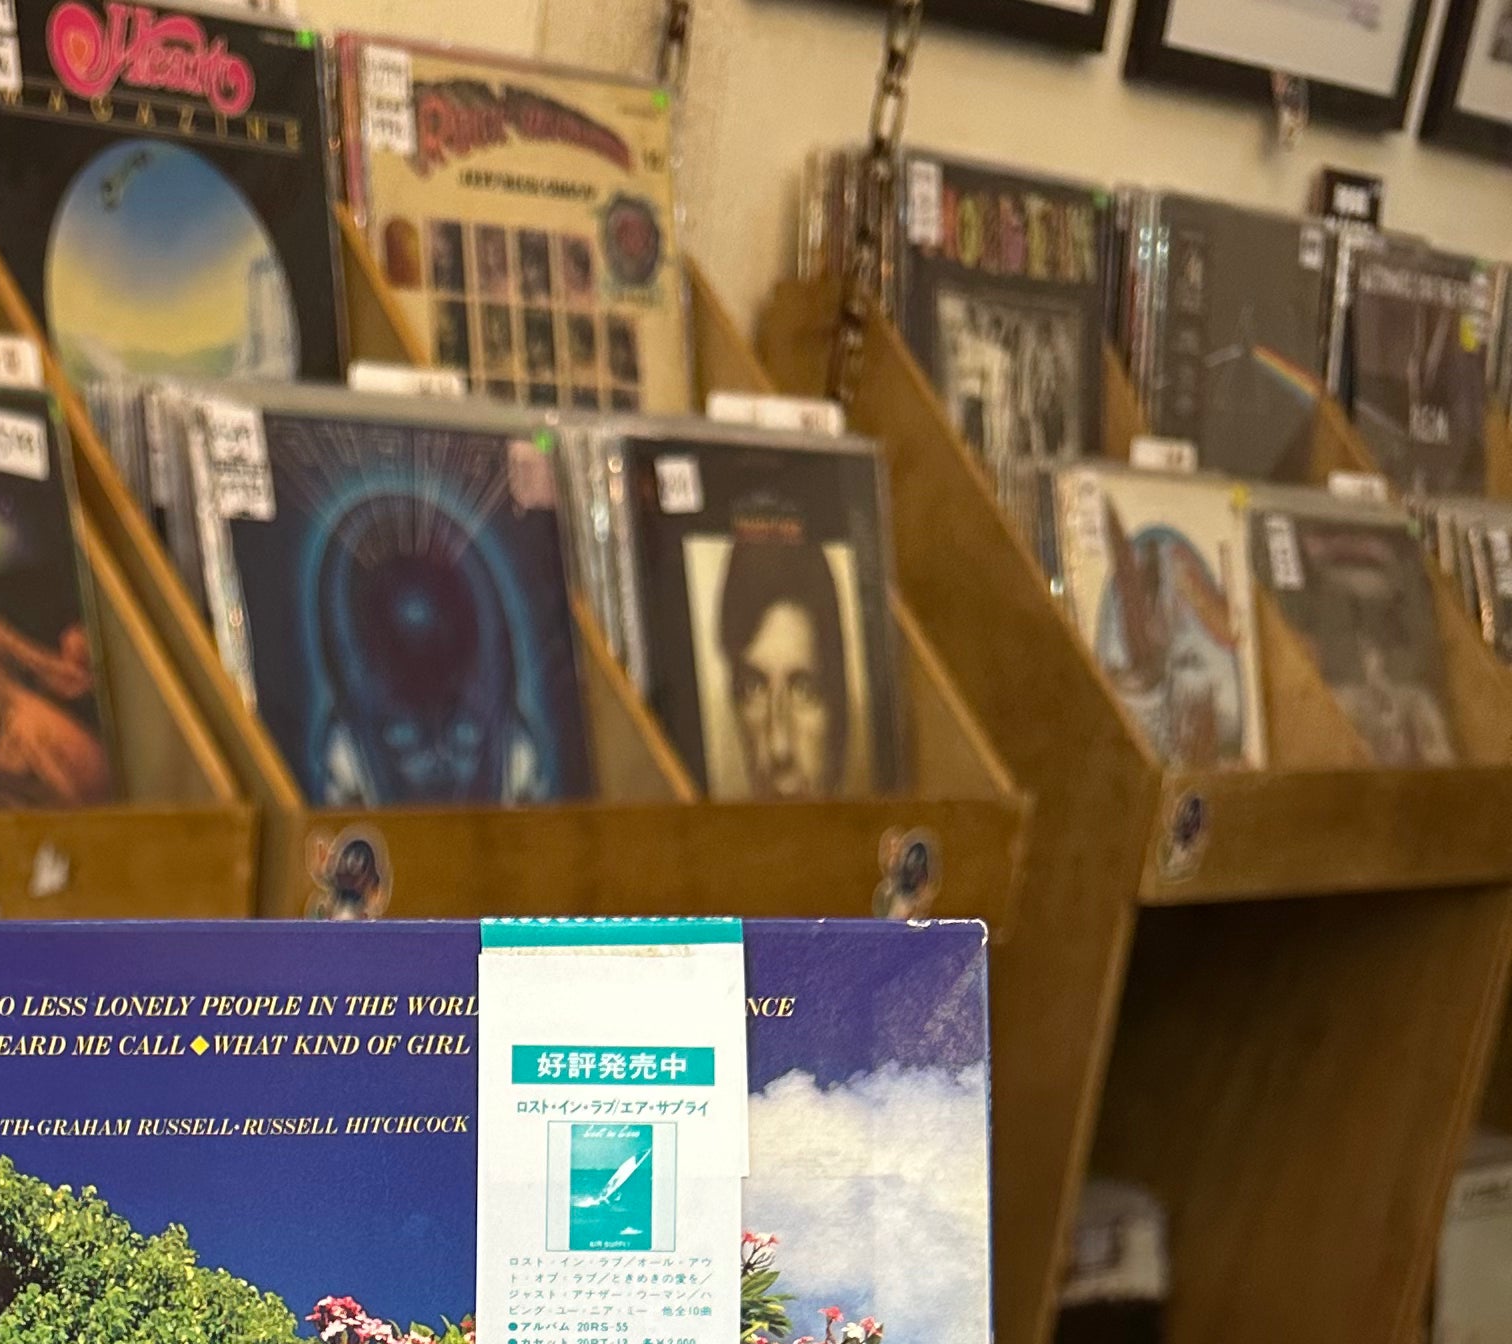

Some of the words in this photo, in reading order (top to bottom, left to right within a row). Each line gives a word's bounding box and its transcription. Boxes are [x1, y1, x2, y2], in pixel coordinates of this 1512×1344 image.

[22, 996, 88, 1017] LESS
[94, 996, 196, 1017] LONELY
[200, 996, 302, 1017] PEOPLE
[308, 996, 338, 1017] IN
[345, 996, 398, 1017] THE
[407, 996, 478, 1017] WORL
[746, 996, 795, 1017] NCE
[76, 1035, 112, 1056] ME
[119, 1035, 186, 1056] CALL
[214, 1035, 288, 1056] WHAT
[293, 1035, 360, 1056] KIND
[367, 1035, 401, 1056] OF
[407, 1035, 471, 1056] GIRL
[538, 1051, 687, 1079] 好評発売中
[37, 1116, 131, 1134] GRAHAM
[137, 1116, 234, 1134] RUSSELL
[241, 1116, 338, 1134] RUSSELL
[345, 1116, 468, 1134] HITCHCOCK
[520, 1322, 570, 1332] アルバム
